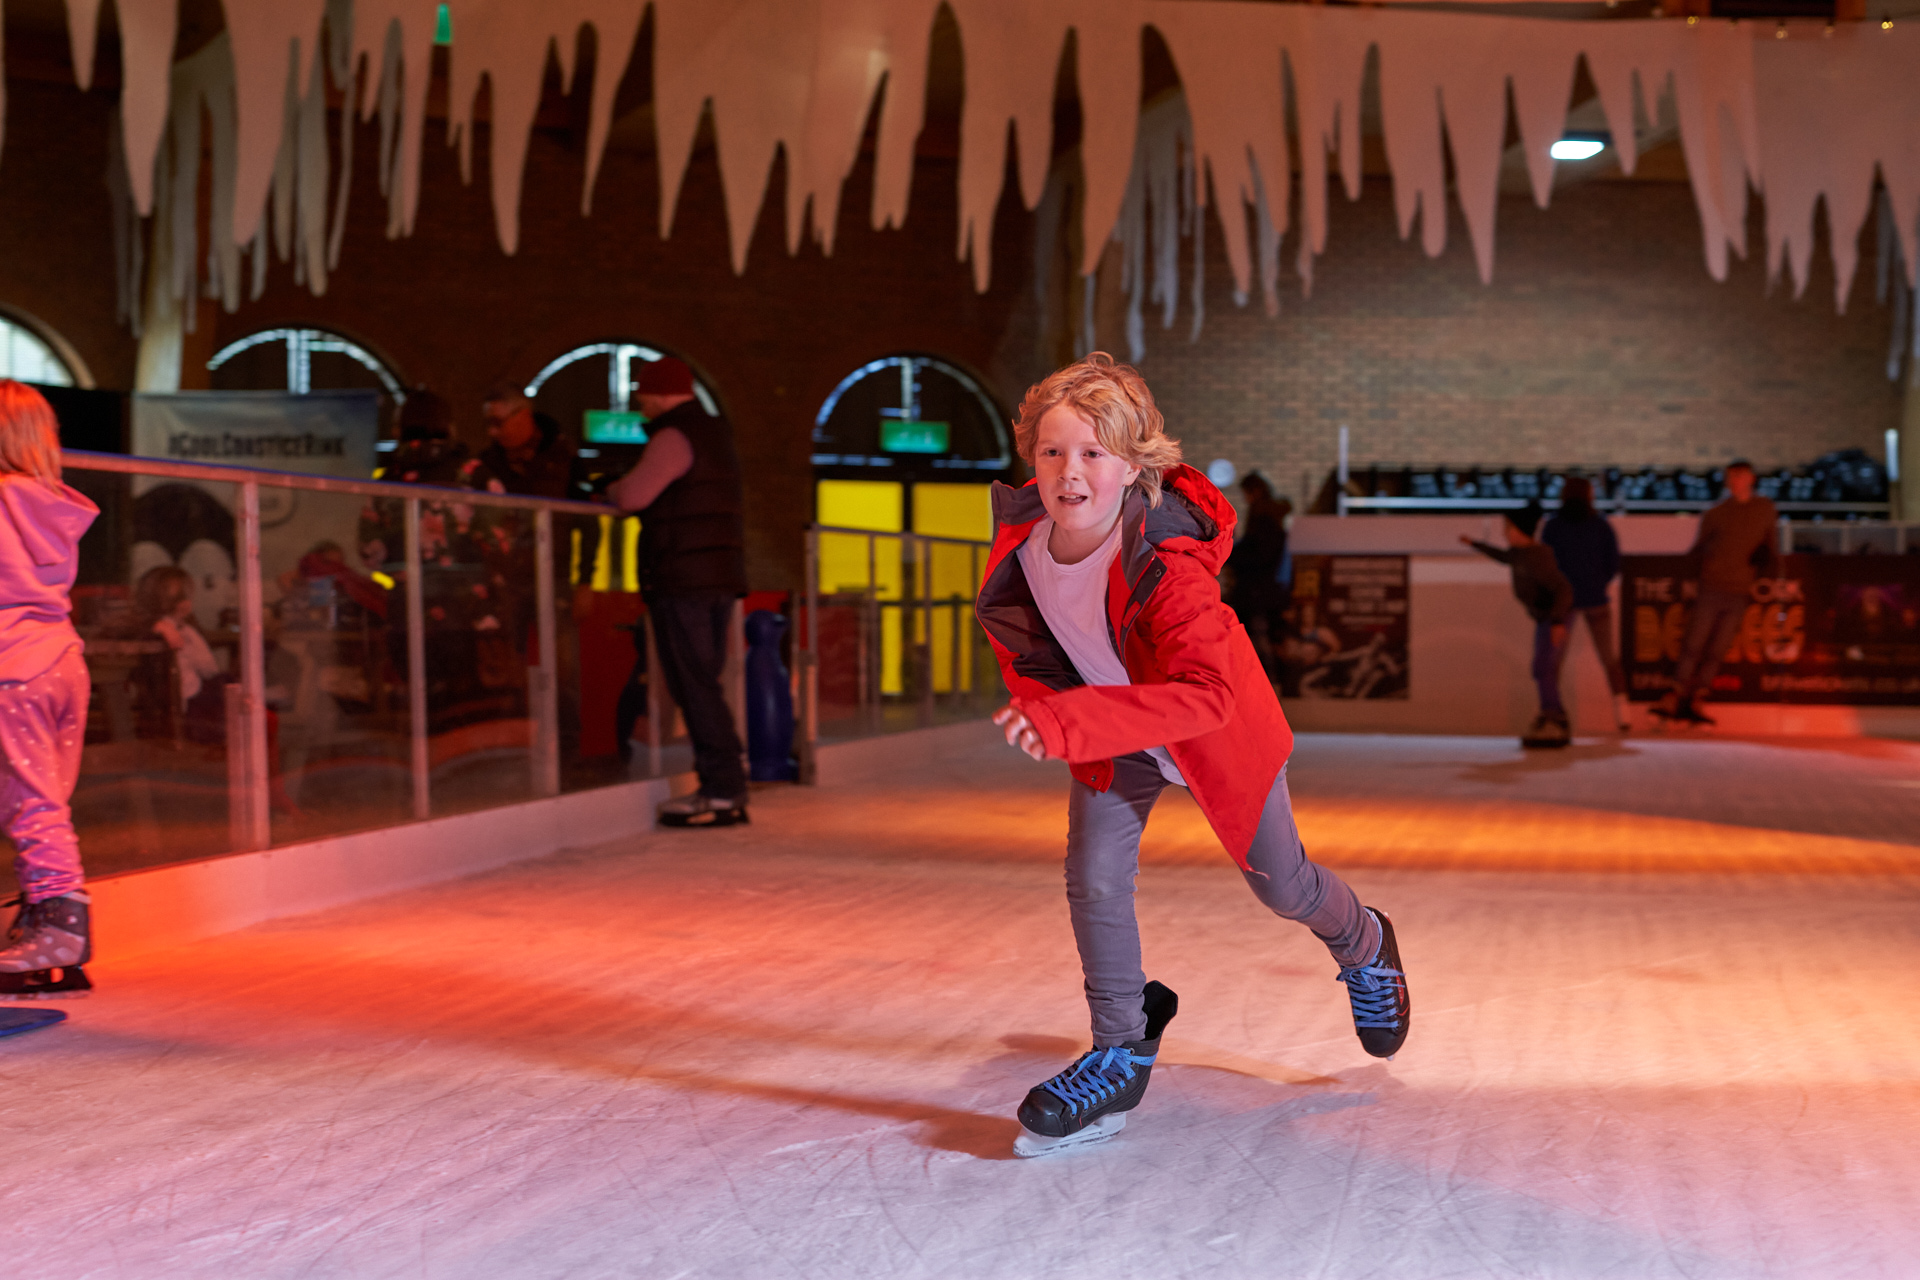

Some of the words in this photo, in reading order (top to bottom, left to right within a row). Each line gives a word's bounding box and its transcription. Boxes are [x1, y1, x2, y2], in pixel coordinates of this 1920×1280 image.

[1634, 577, 1673, 602] THE
[1750, 577, 1805, 602] ORK
[1634, 603, 1686, 663] BE
